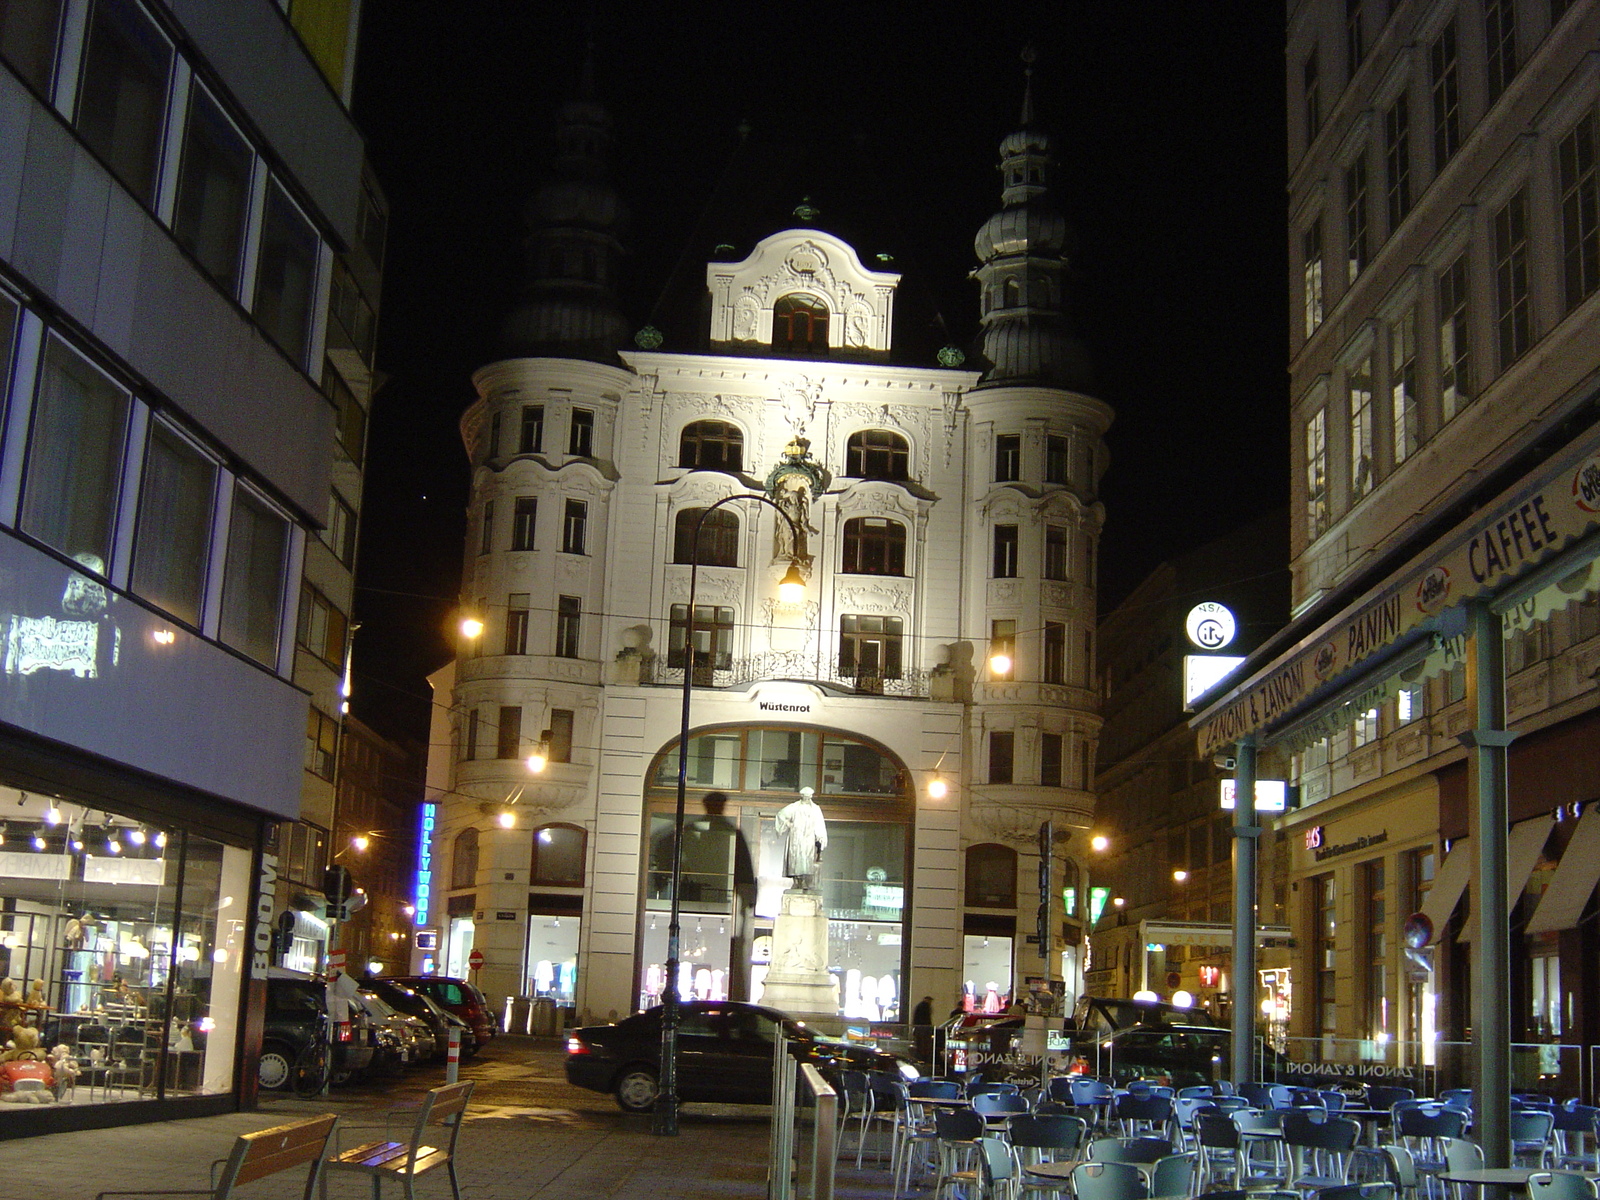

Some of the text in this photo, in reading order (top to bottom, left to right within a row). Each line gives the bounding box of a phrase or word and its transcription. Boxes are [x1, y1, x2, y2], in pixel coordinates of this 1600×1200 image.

[1469, 495, 1558, 583] CAFFEE
[1347, 593, 1400, 661] PANINI
[760, 701, 810, 712] Wüstenrot
[1206, 699, 1247, 749] ZANONI
[1249, 694, 1259, 725] &
[1260, 661, 1305, 718] ZANONI
[416, 803, 436, 925] HOLLYWOOD
[251, 853, 278, 980] BOOM
